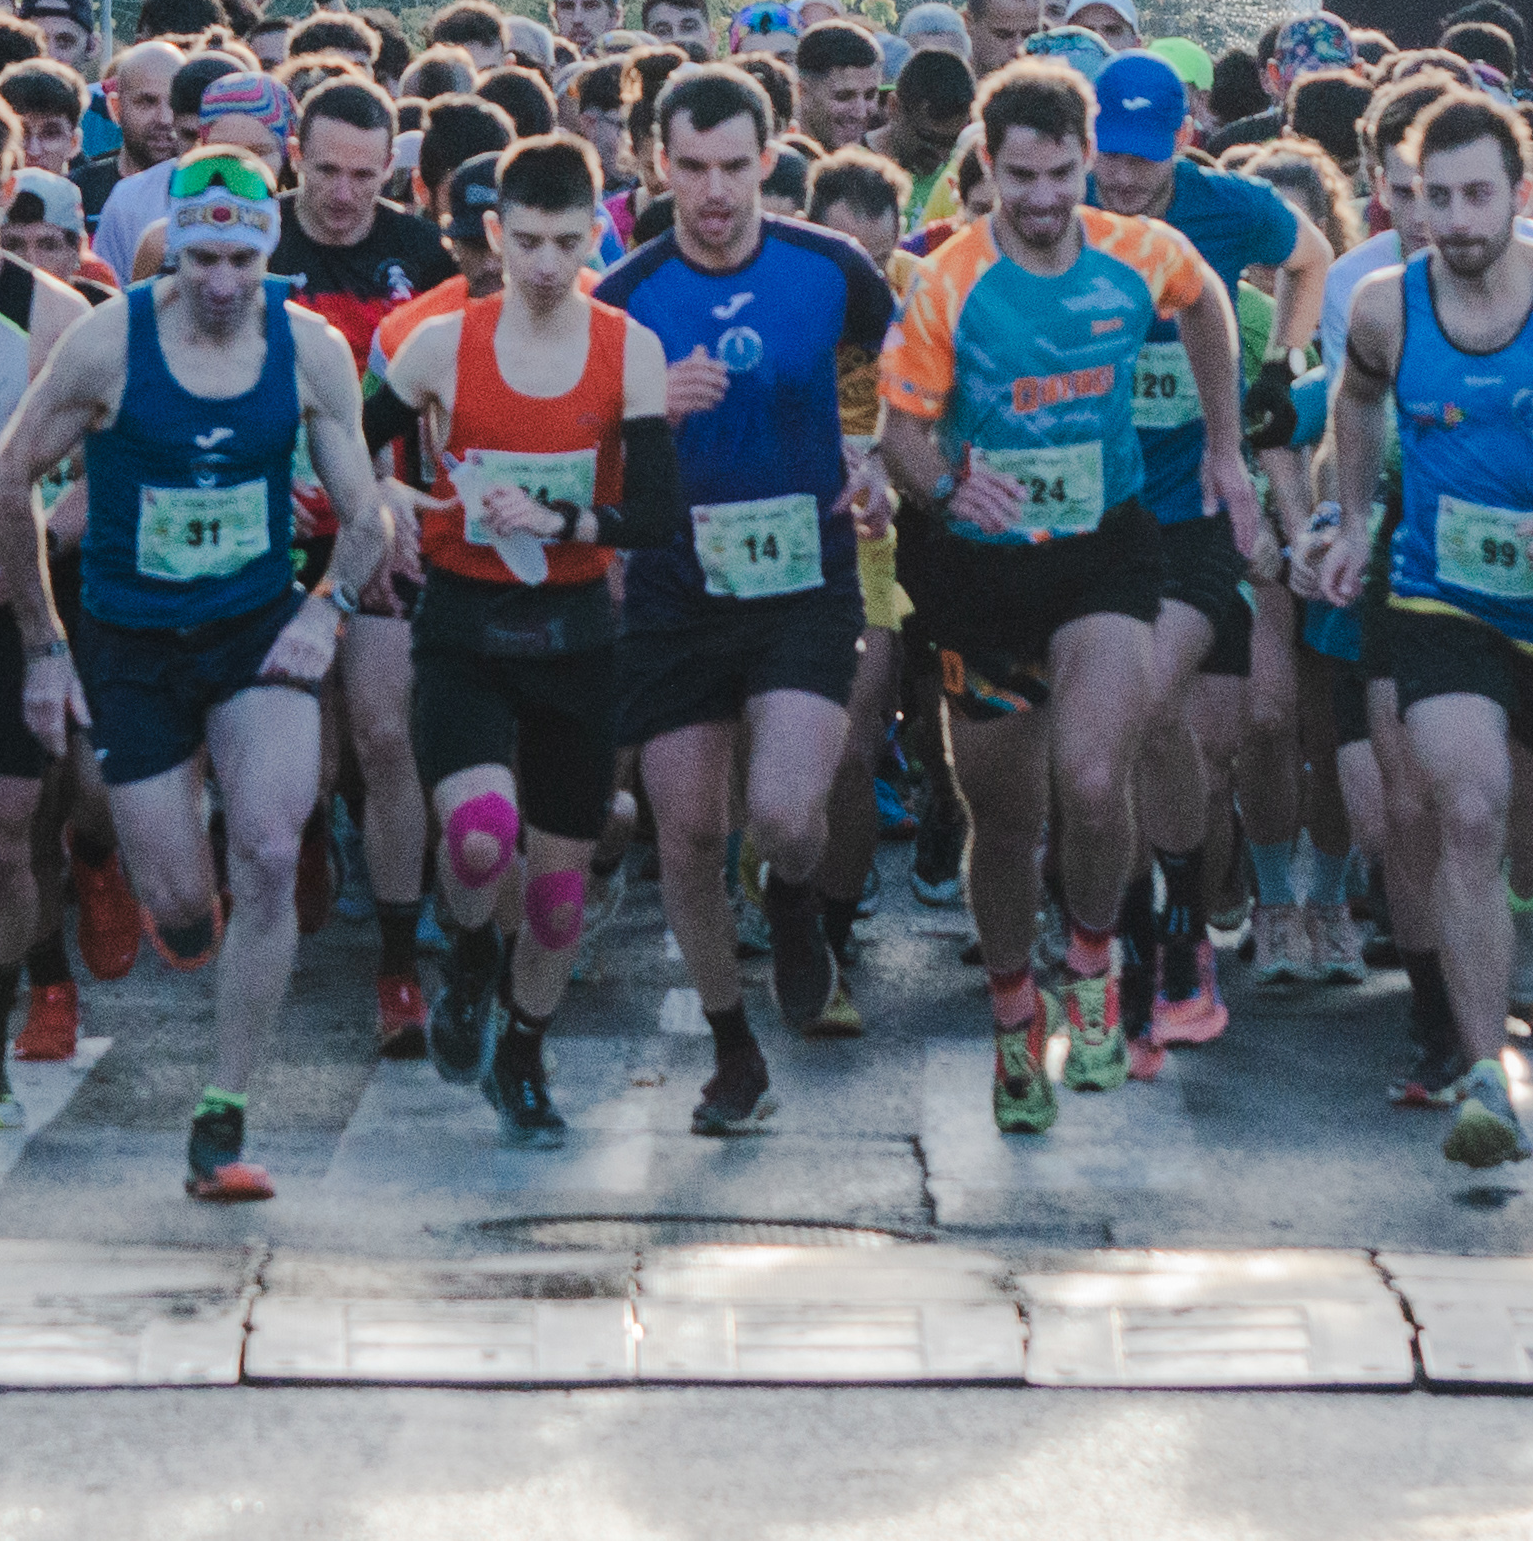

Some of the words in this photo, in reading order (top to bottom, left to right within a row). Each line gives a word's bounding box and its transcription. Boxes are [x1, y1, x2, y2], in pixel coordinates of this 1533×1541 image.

[1016, 475, 1066, 504] 24
[186, 518, 221, 548] 31
[743, 532, 780, 563] 14
